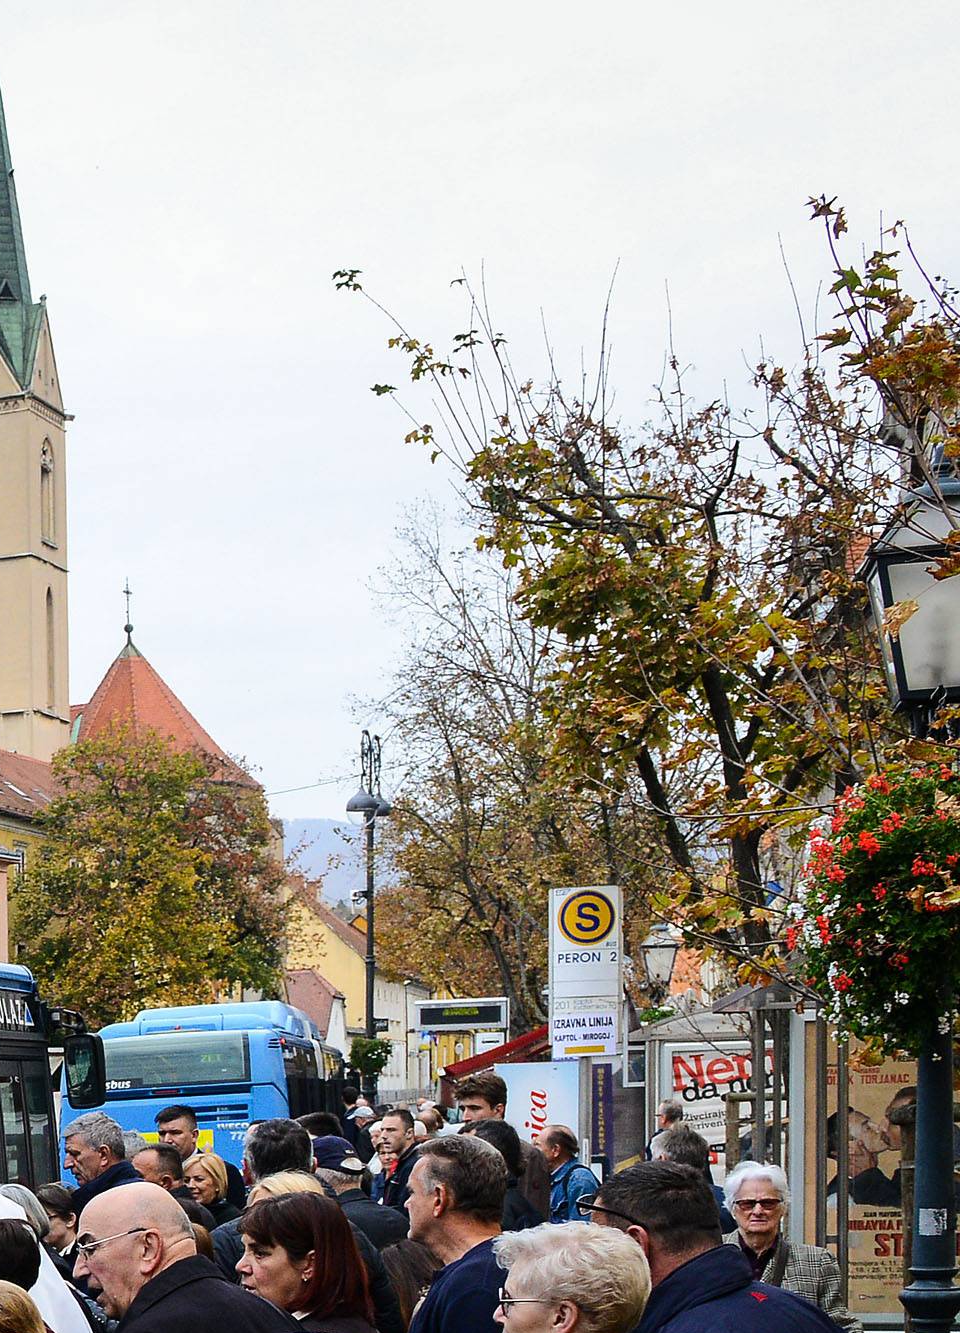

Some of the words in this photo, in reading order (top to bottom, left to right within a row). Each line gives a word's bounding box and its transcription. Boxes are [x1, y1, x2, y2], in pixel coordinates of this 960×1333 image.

[575, 902, 600, 932] S
[557, 951, 601, 964] PERON
[609, 951, 617, 962] 2
[553, 1017, 587, 1029] IZRAVNA
[588, 1016, 613, 1027] LINIJA
[582, 1032, 610, 1041] MIROGOJ
[105, 1080, 131, 1090] sbus
[682, 1080, 720, 1102] da
